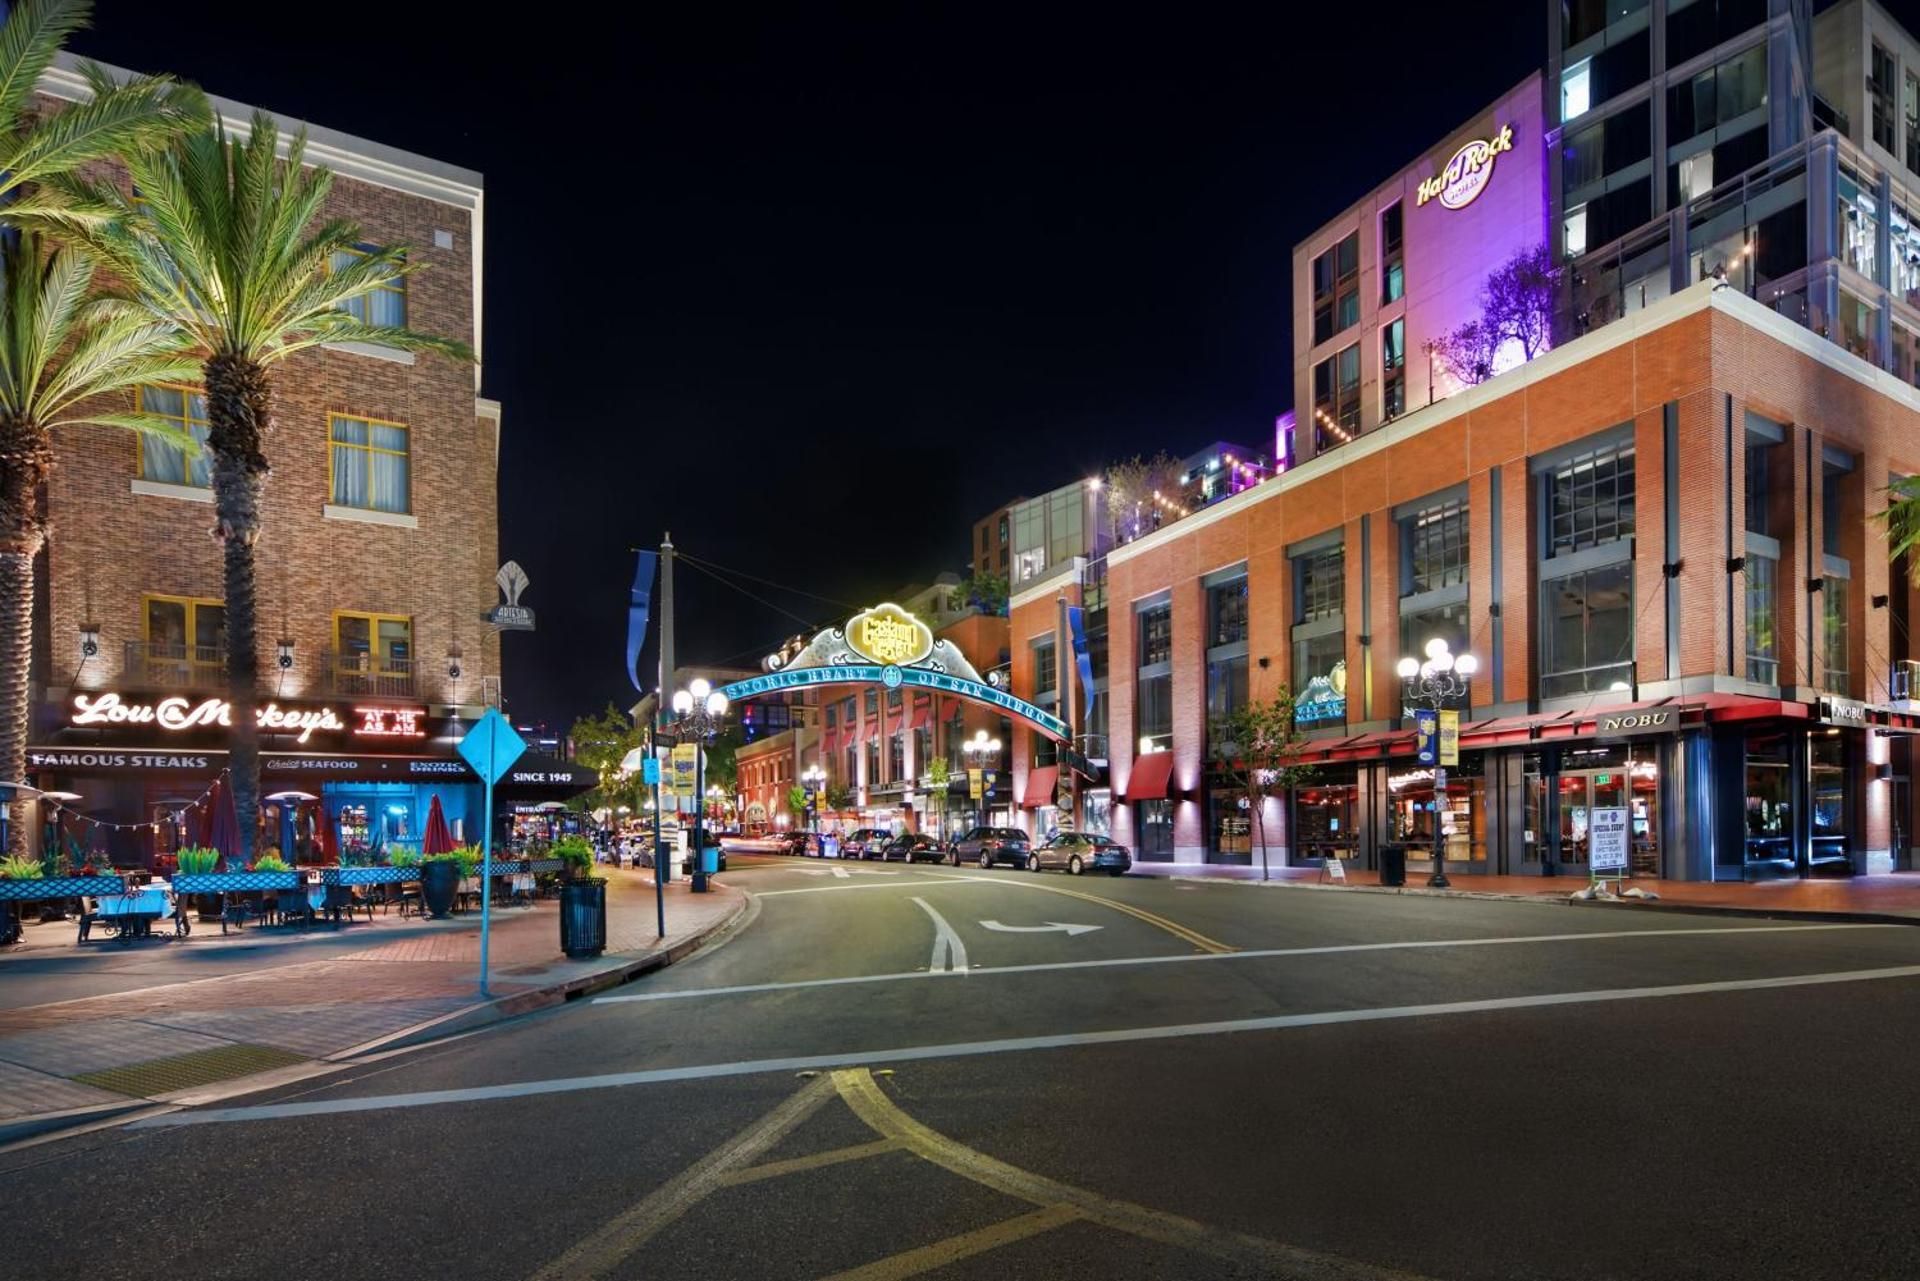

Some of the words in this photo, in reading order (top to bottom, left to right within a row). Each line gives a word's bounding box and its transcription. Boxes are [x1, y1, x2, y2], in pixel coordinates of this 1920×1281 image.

[1416, 154, 1466, 206] Hard
[1465, 124, 1512, 173] Rock
[808, 669, 869, 685] HEART
[918, 674, 941, 687] OF
[950, 679, 984, 697] SAN
[995, 692, 1046, 724] DIEGO
[72, 693, 154, 723] Lou
[1836, 705, 1863, 720] NOBU
[1603, 712, 1669, 730] NOBU
[32, 754, 126, 767] FAMOUS
[131, 755, 208, 768] STEAKS
[301, 761, 358, 769] SEAFOOD
[513, 773, 545, 781] SINCE
